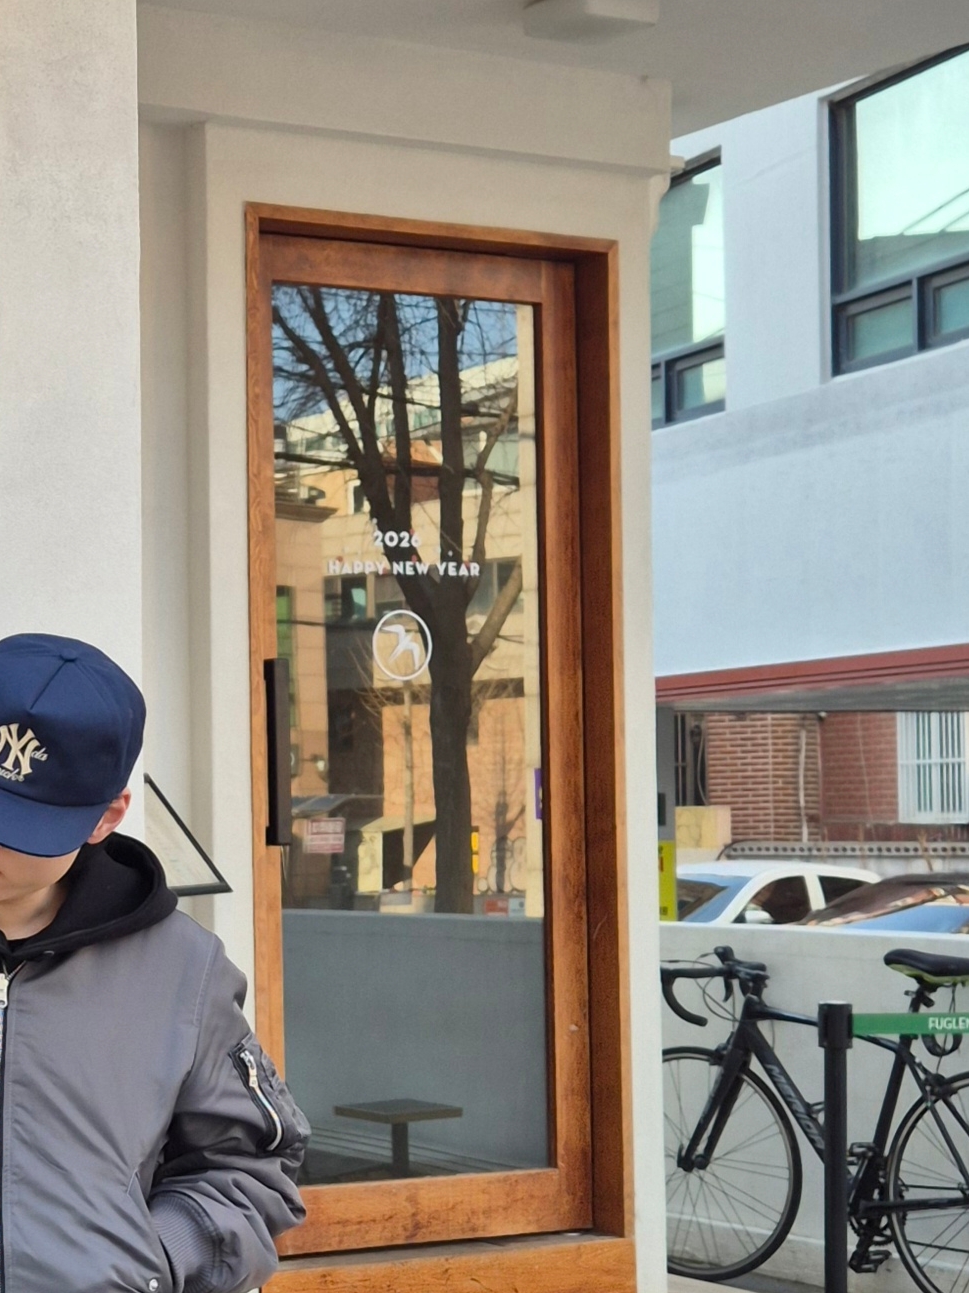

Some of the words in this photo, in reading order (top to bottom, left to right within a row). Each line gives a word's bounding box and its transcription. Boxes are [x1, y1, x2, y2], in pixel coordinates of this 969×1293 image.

[373, 529, 421, 548] 2026
[327, 560, 387, 576] HAPPY
[392, 560, 430, 577] NEW
[436, 560, 480, 577] YEAR
